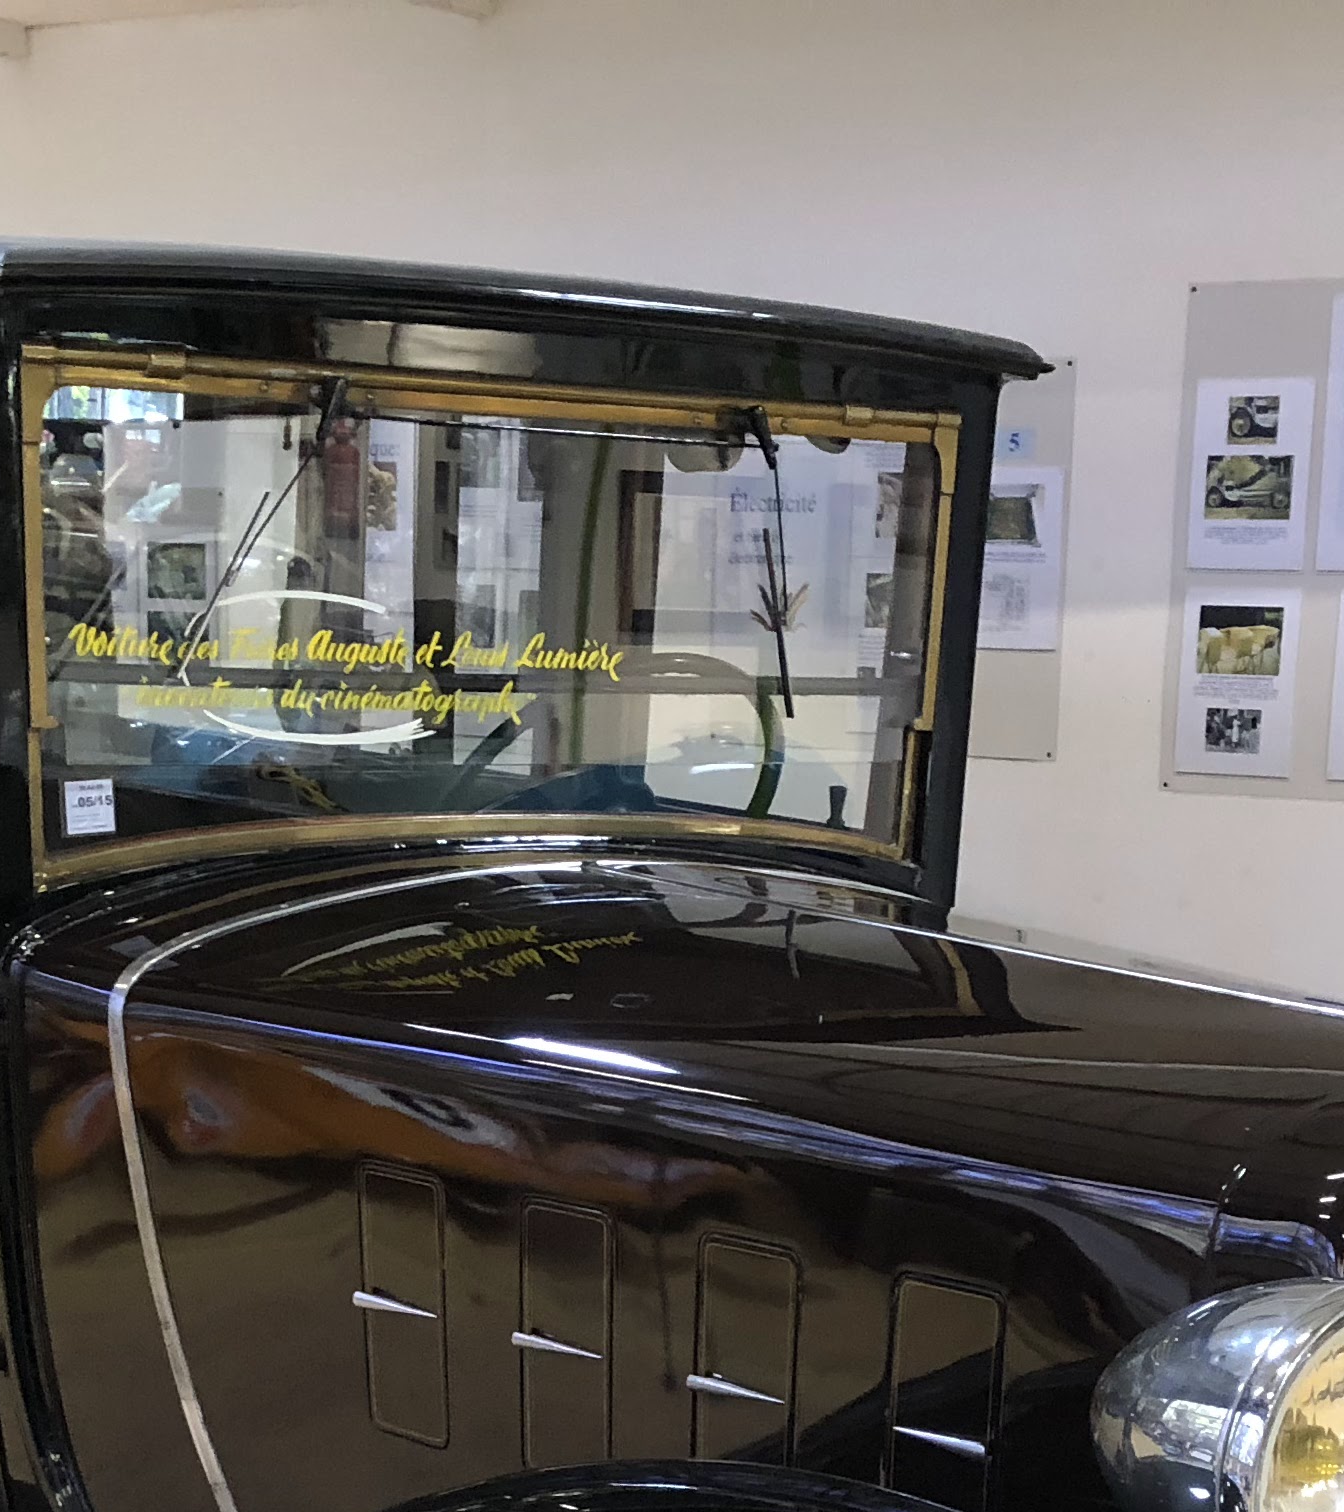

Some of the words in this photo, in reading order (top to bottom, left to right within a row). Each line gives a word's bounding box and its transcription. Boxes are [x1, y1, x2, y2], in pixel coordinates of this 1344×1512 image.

[1008, 432, 1021, 452] 5
[68, 622, 175, 666] Voiture
[307, 626, 408, 675] Auguste
[415, 630, 443, 669] et
[514, 630, 624, 683] Lumière
